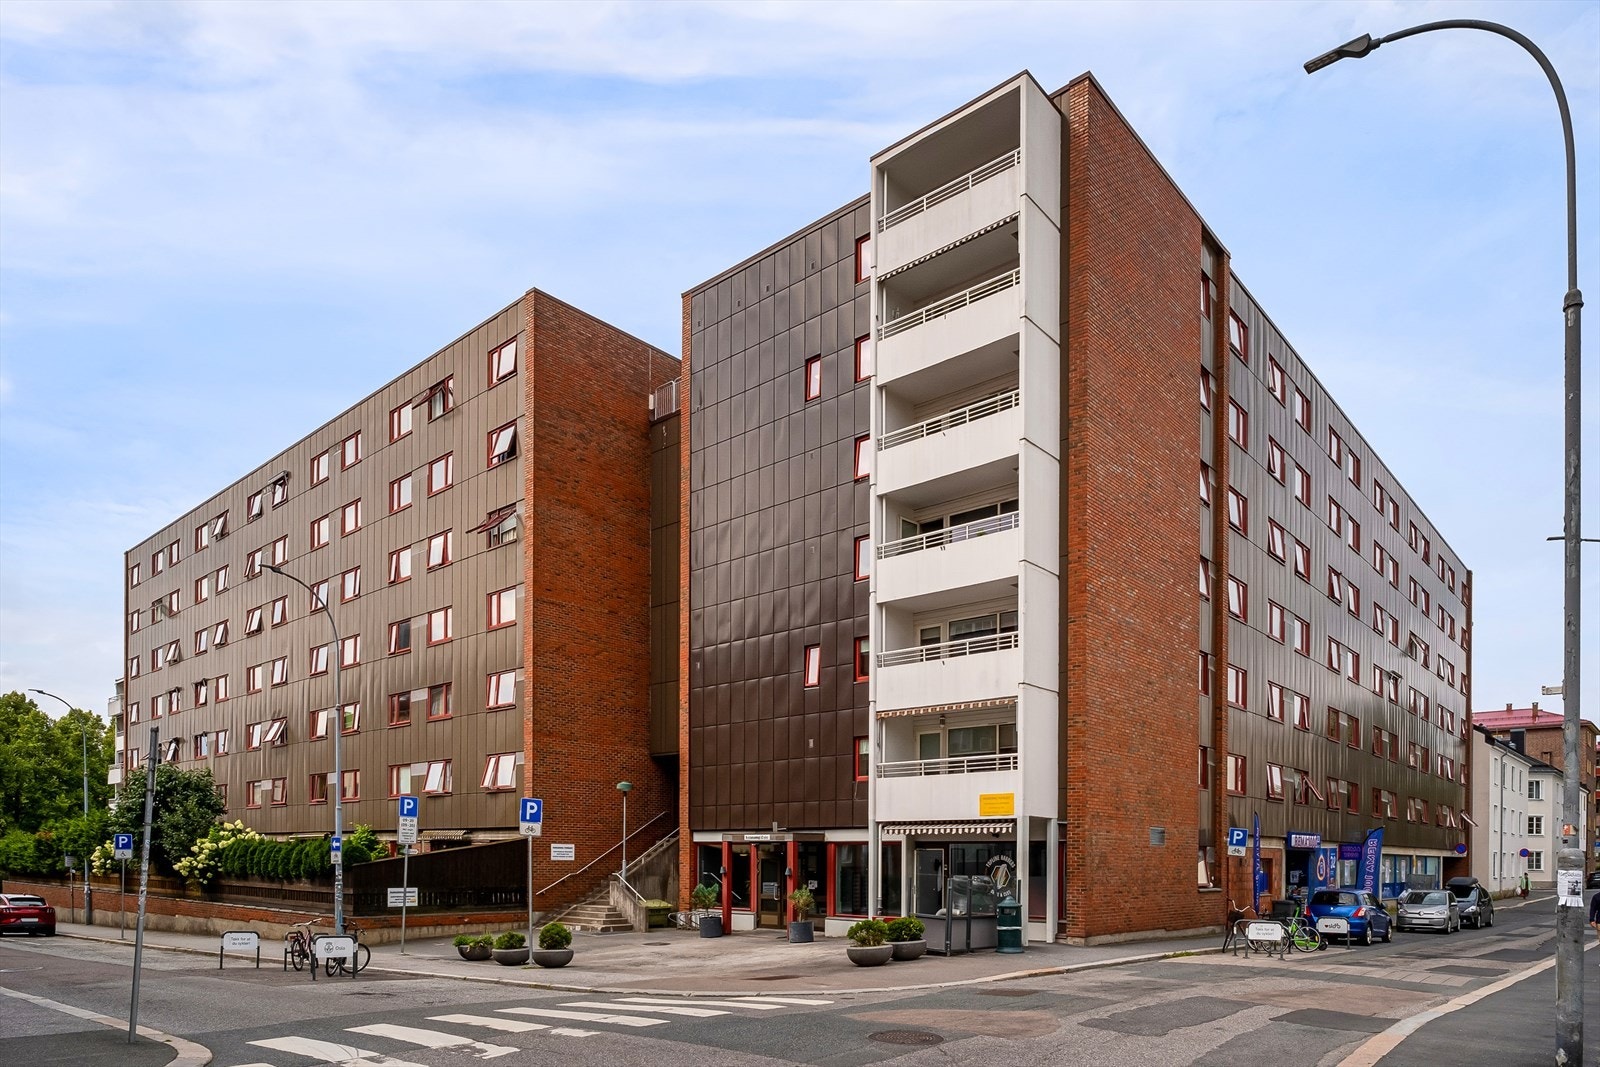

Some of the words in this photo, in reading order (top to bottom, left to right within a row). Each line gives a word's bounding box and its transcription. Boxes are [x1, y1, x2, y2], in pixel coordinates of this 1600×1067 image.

[403, 799, 414, 815] P
[526, 801, 538, 820] P
[118, 836, 128, 848] P
[1232, 830, 1244, 844] P
